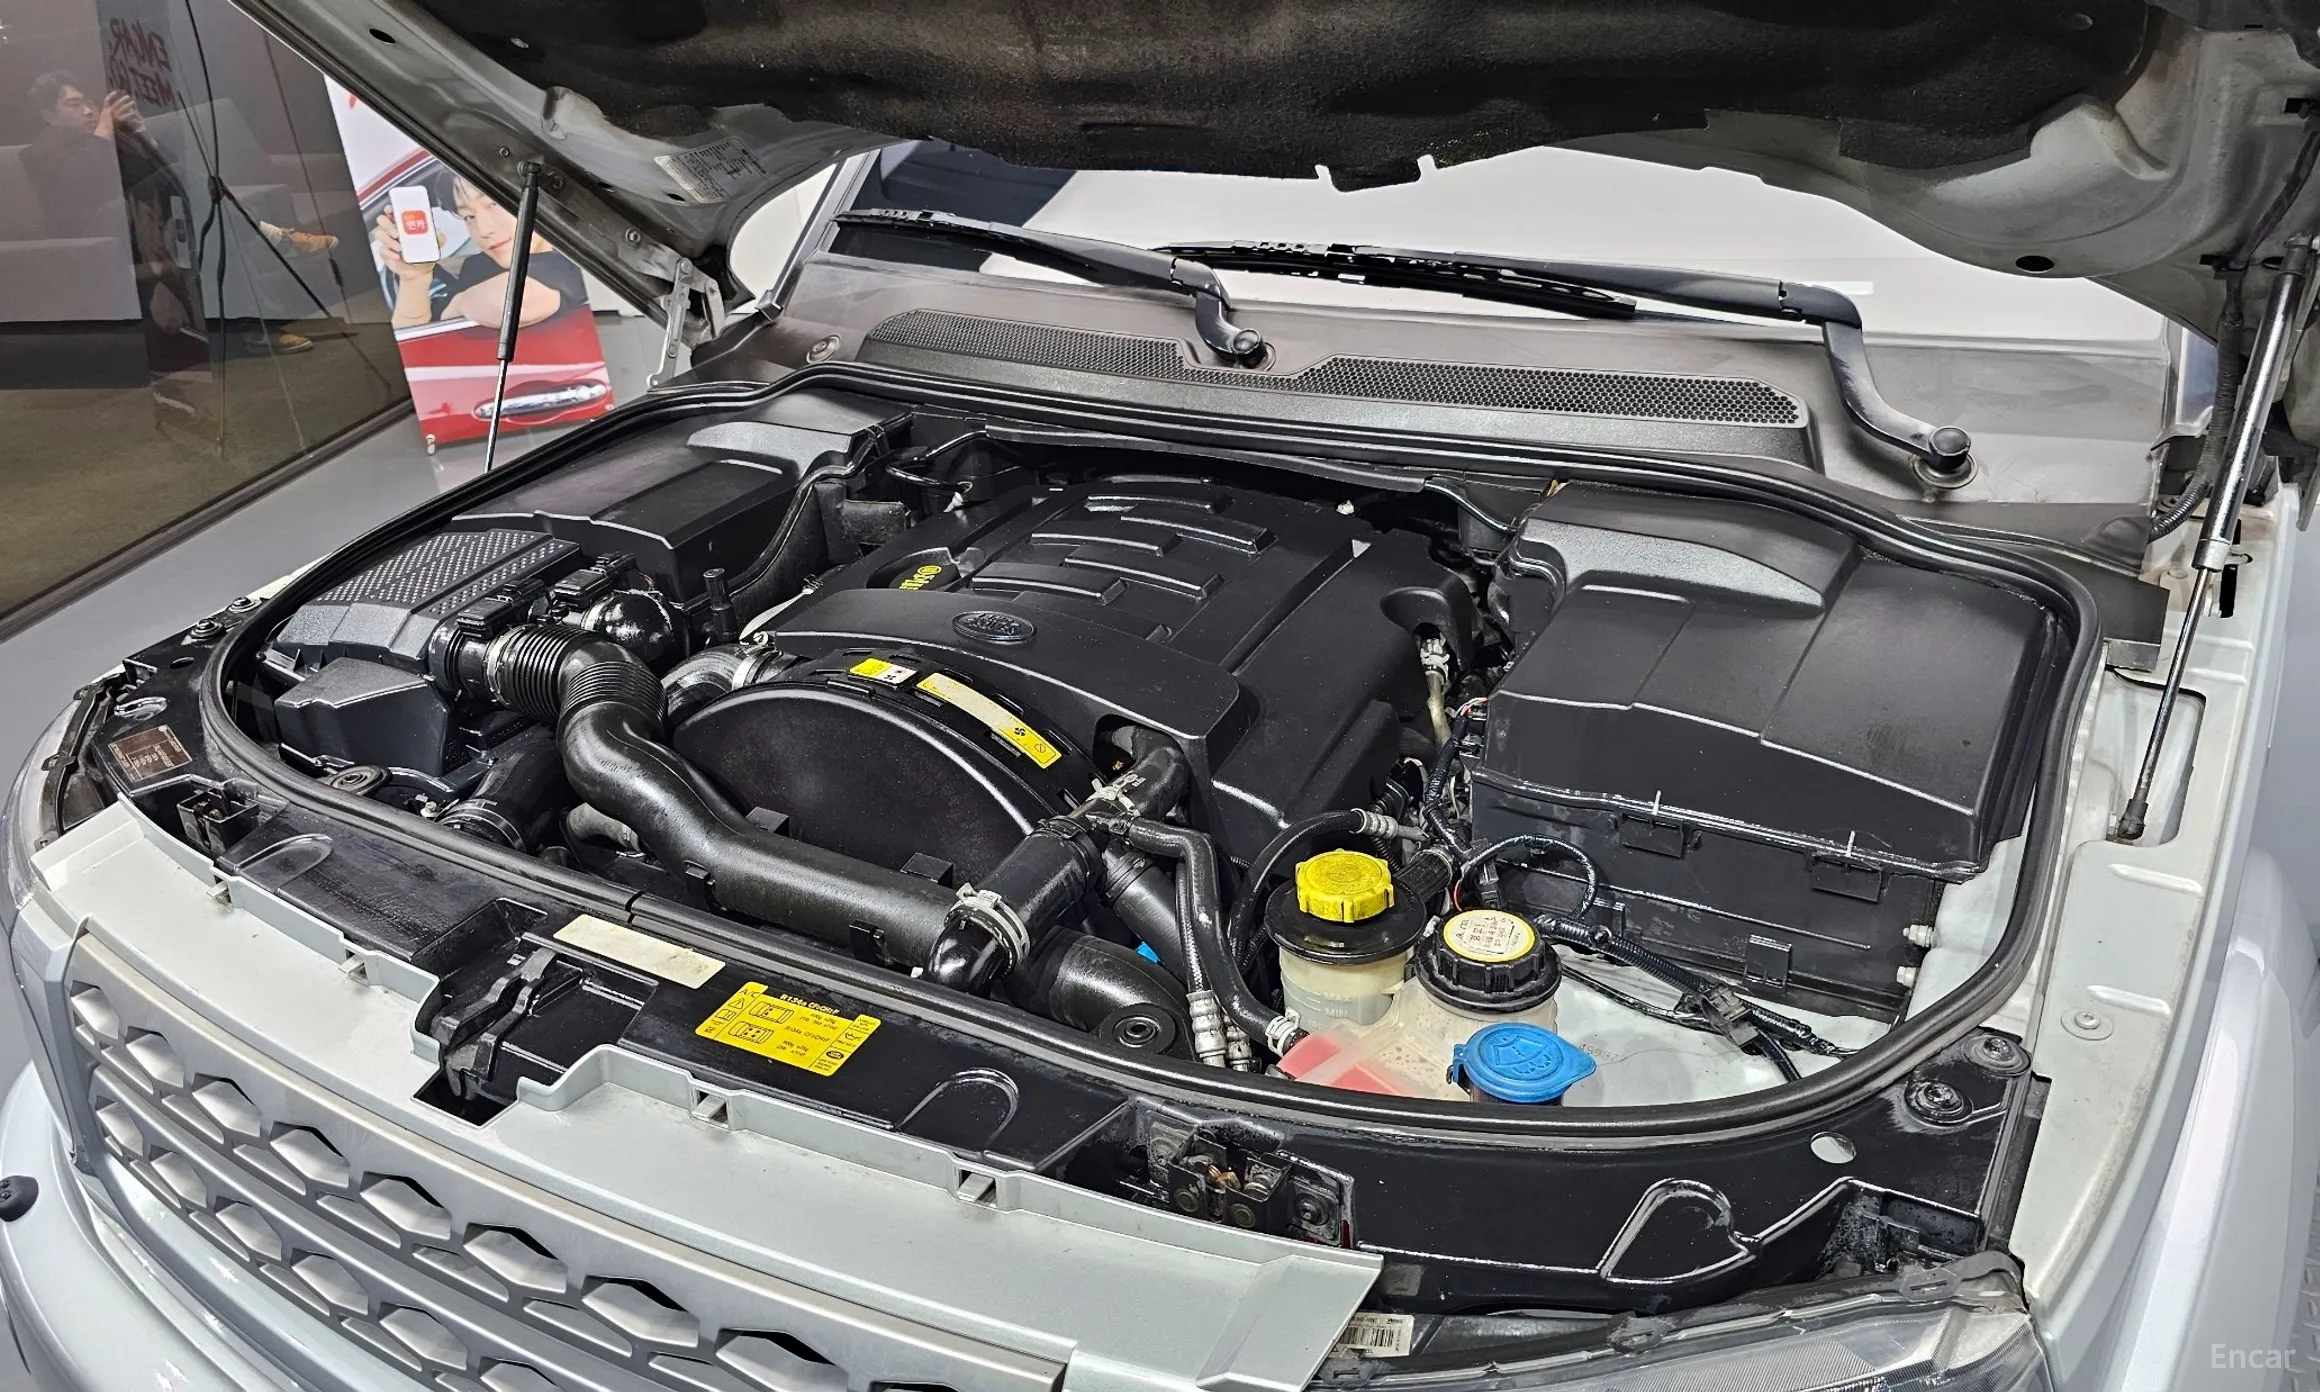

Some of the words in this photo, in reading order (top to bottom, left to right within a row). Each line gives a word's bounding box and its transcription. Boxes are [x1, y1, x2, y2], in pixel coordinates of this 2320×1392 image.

[741, 988, 762, 999] A/C
[1323, 991, 1352, 1002] MAX
[1324, 1007, 1348, 1018] MIN
